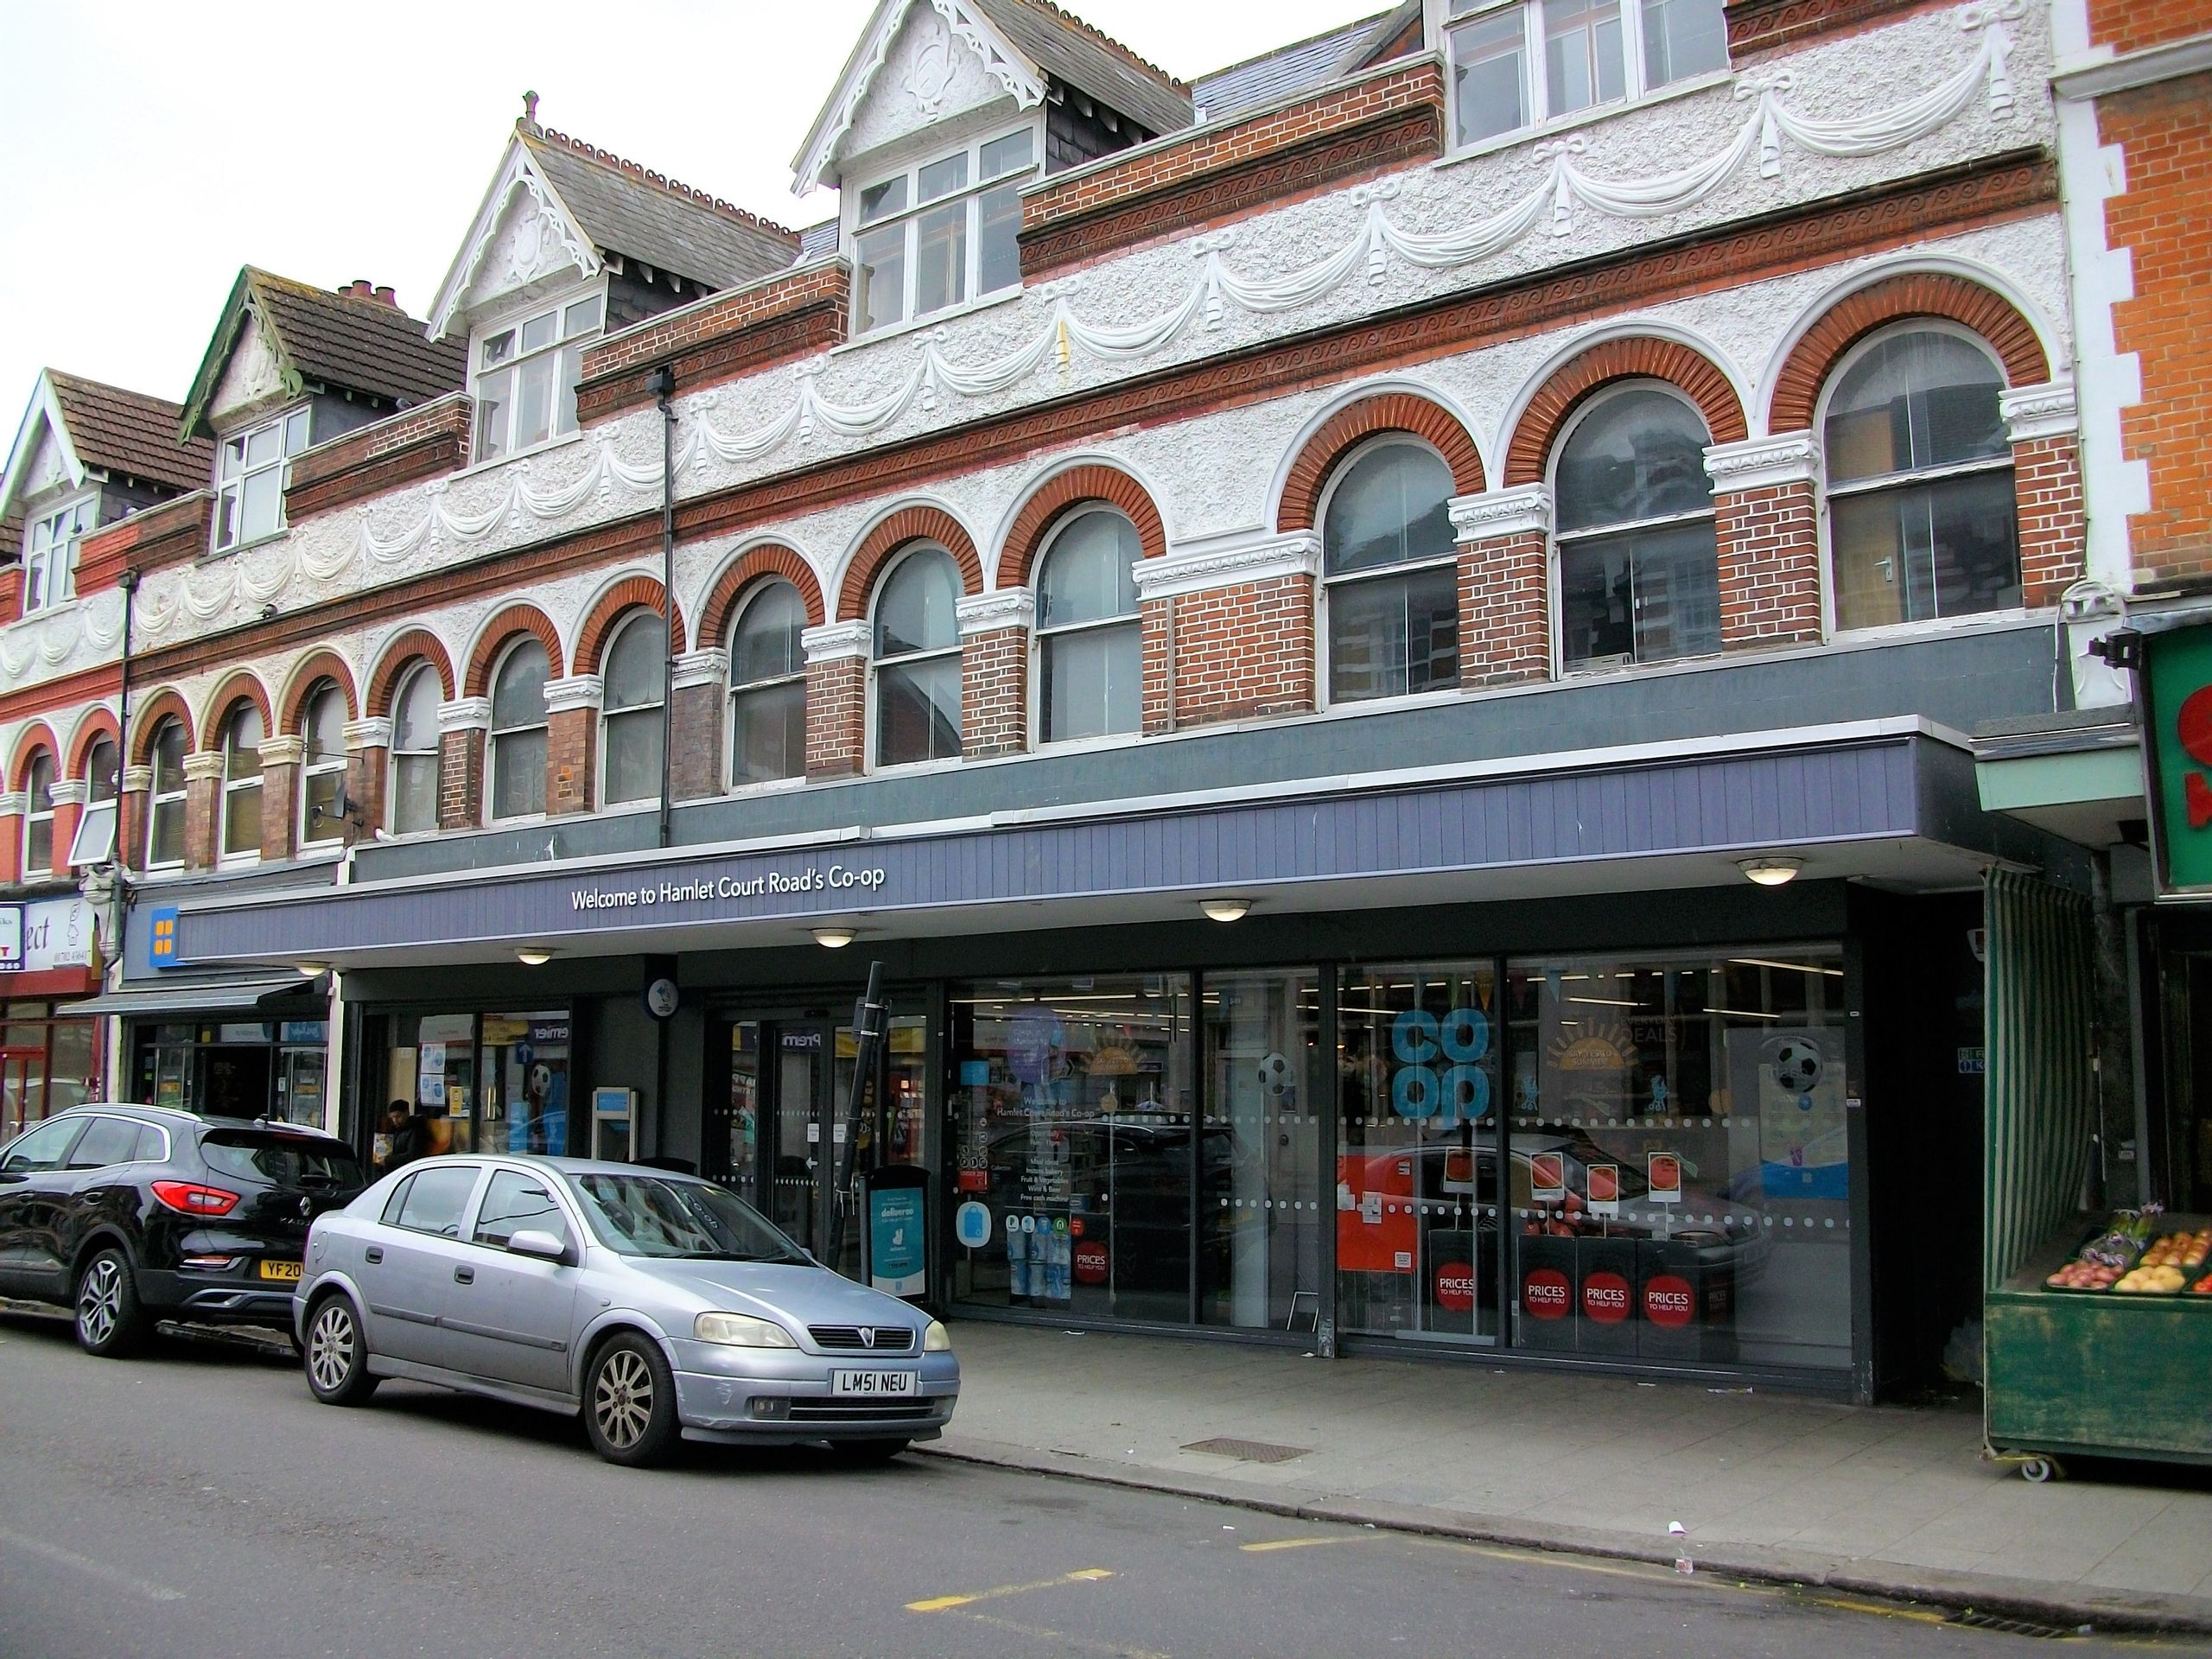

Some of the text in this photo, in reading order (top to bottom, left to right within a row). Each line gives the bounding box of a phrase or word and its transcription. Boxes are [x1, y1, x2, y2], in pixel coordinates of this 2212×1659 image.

[571, 865, 885, 910] Welcome to Hamlet Court Road's Co-op
[1621, 1028, 1678, 1042] DEALS
[1024, 1096, 1058, 1106] Welcome
[997, 1108, 1023, 1117] Hamlet
[1071, 1109, 1095, 1120] Co-op
[1077, 1255, 1106, 1265] PRICES
[268, 1262, 301, 1277] YF20
[1440, 1278, 1474, 1289] PRICES
[1528, 1285, 1566, 1297] PRICES
[1586, 1288, 1624, 1301] PRICES
[1599, 1300, 1611, 1308] HELP
[1649, 1293, 1688, 1305] PRICES
[1659, 1303, 1674, 1312] HELP
[842, 1374, 907, 1391] LM51 NEU
